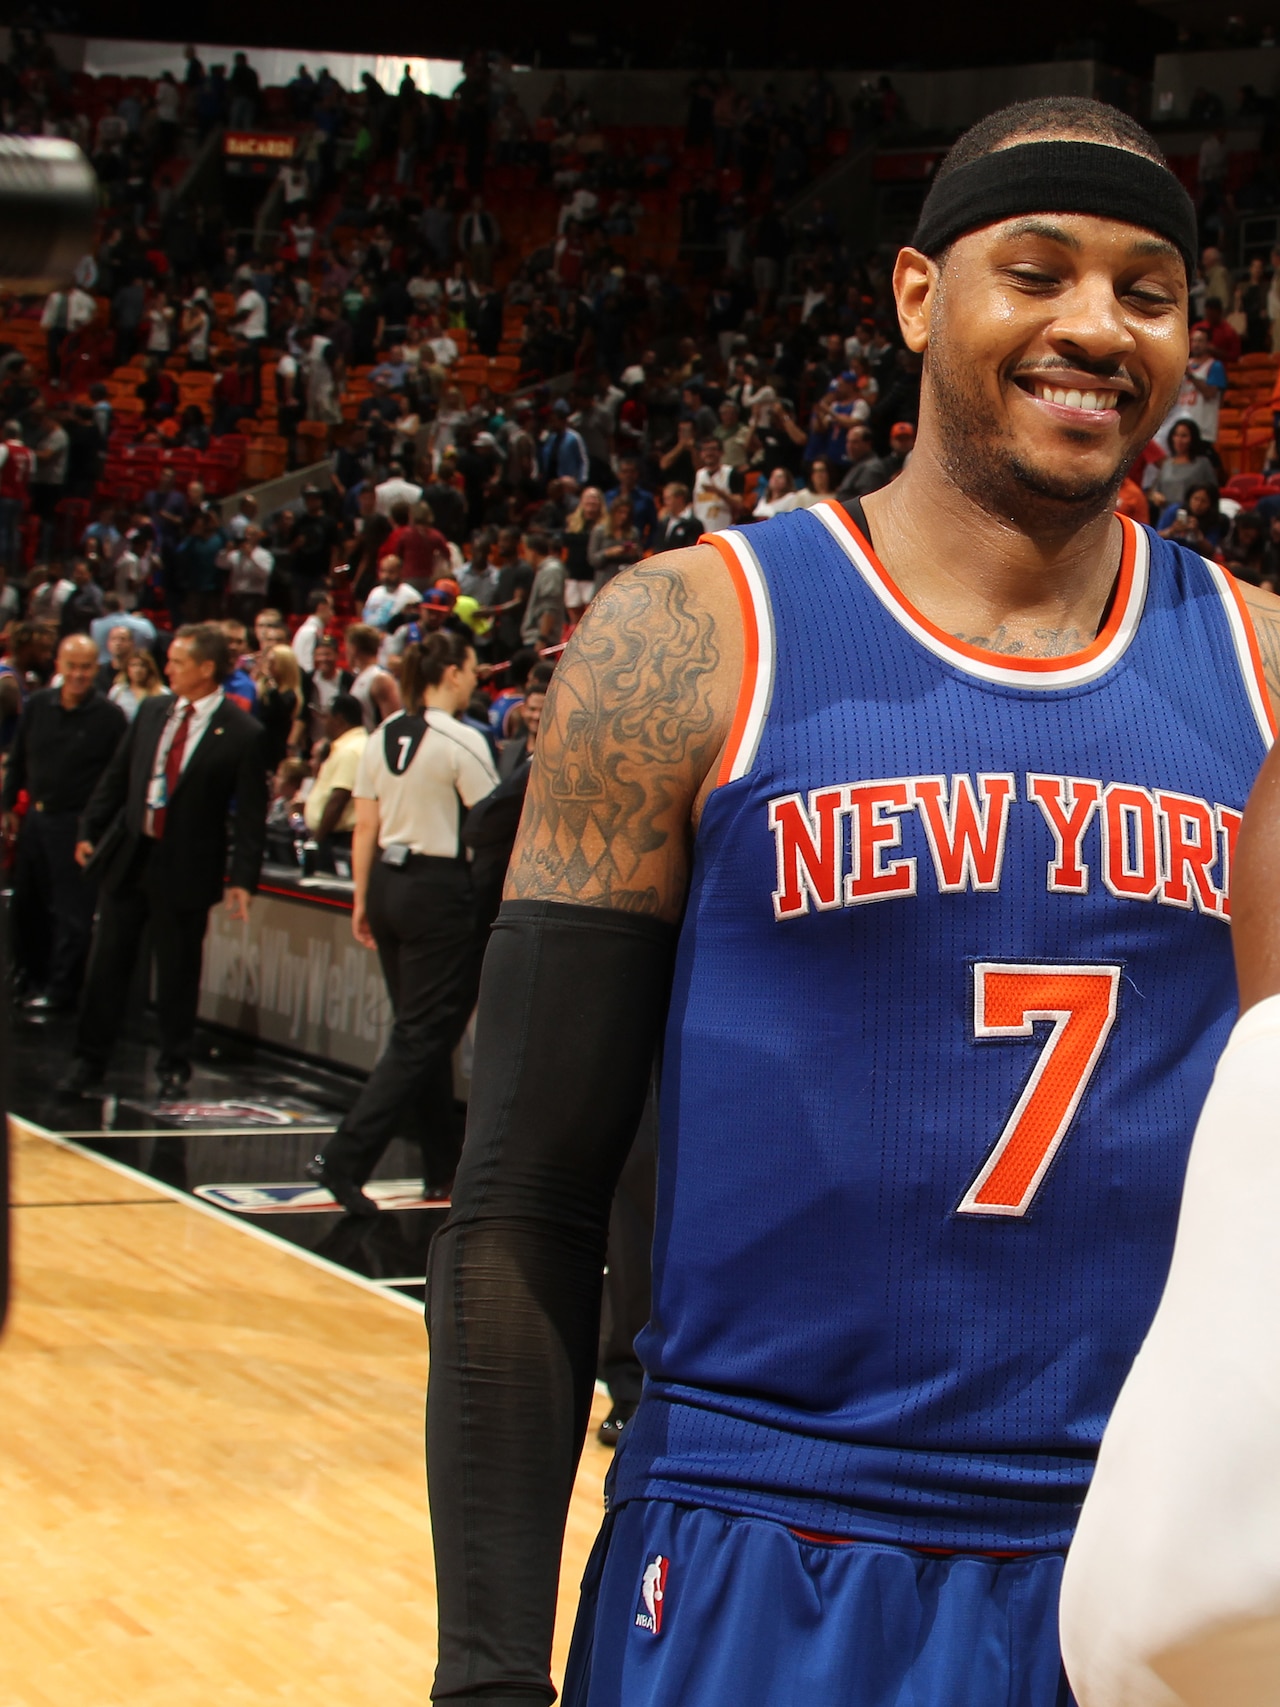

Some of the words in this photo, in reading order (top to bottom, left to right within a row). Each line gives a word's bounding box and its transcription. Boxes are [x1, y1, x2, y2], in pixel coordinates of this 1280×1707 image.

[768, 772, 1017, 923] NEW
[955, 961, 1122, 1217] 7
[635, 1613, 653, 1630] NBA
